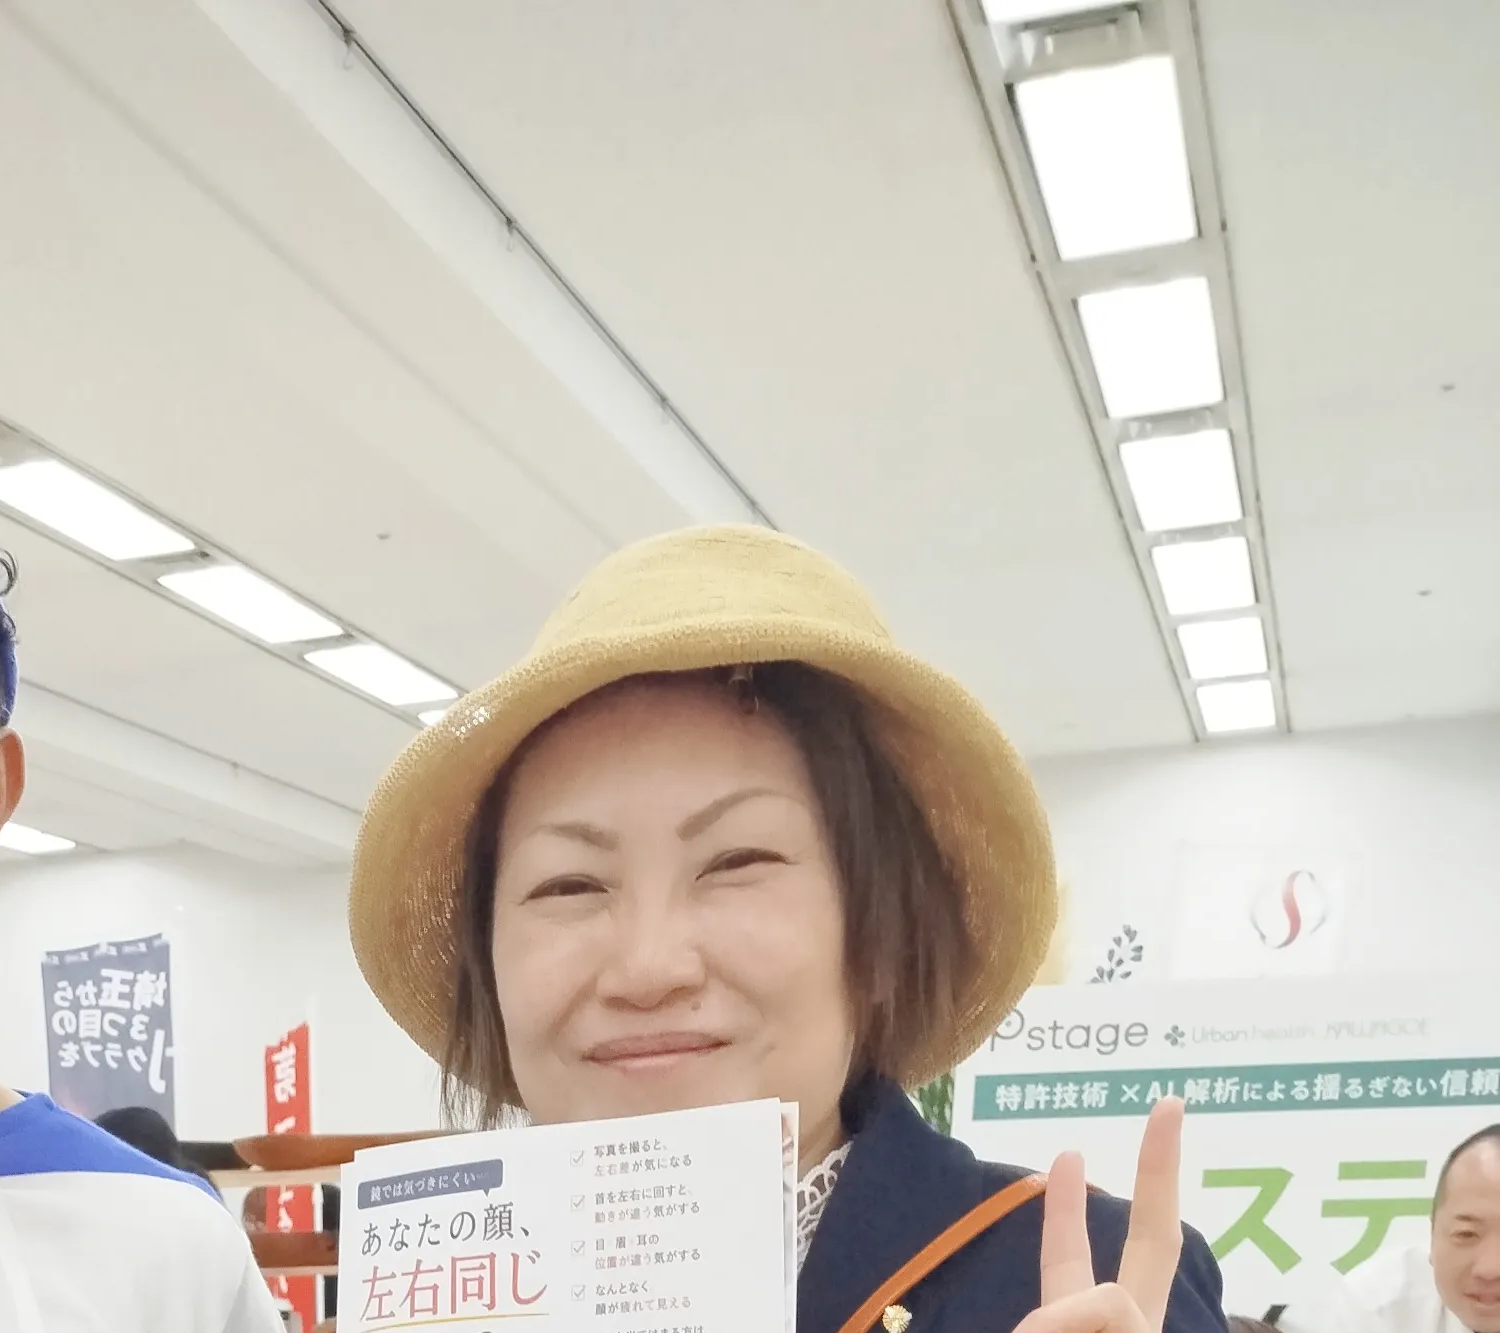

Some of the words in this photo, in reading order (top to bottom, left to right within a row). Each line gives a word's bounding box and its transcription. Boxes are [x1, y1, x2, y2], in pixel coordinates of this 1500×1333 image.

[594, 1154, 692, 1177] 左右差が気になる
[594, 1201, 700, 1223] 動きが違う気がする
[1202, 1160, 1436, 1275] ステ
[362, 1201, 530, 1257] あなたの顔、
[595, 1248, 700, 1270] 位置が違う気がする
[359, 1250, 548, 1322] 左右同じ
[595, 1296, 692, 1316] 顔が疲れて見える
